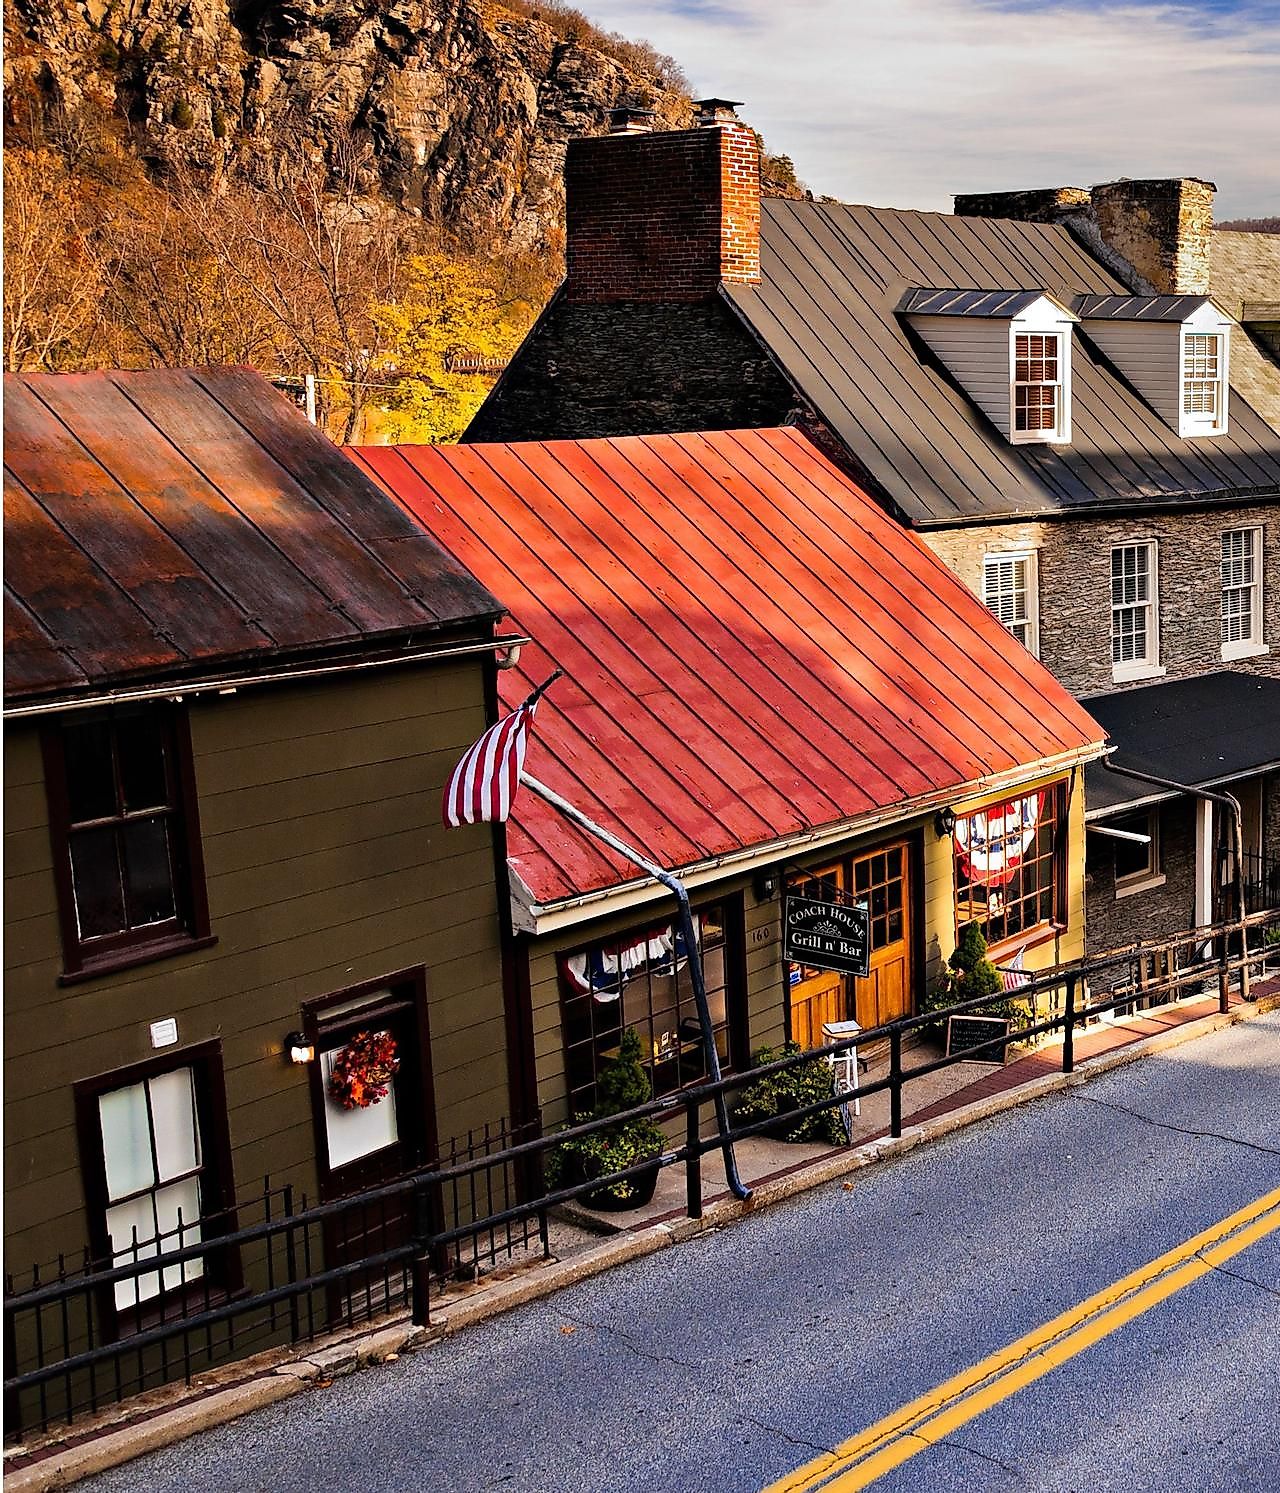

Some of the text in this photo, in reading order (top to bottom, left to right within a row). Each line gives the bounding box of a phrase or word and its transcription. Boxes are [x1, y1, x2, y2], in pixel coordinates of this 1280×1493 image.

[752, 928, 769, 942] 160
[788, 906, 866, 940] COACH HOUSE
[792, 932, 862, 956] Grill n' Bar
